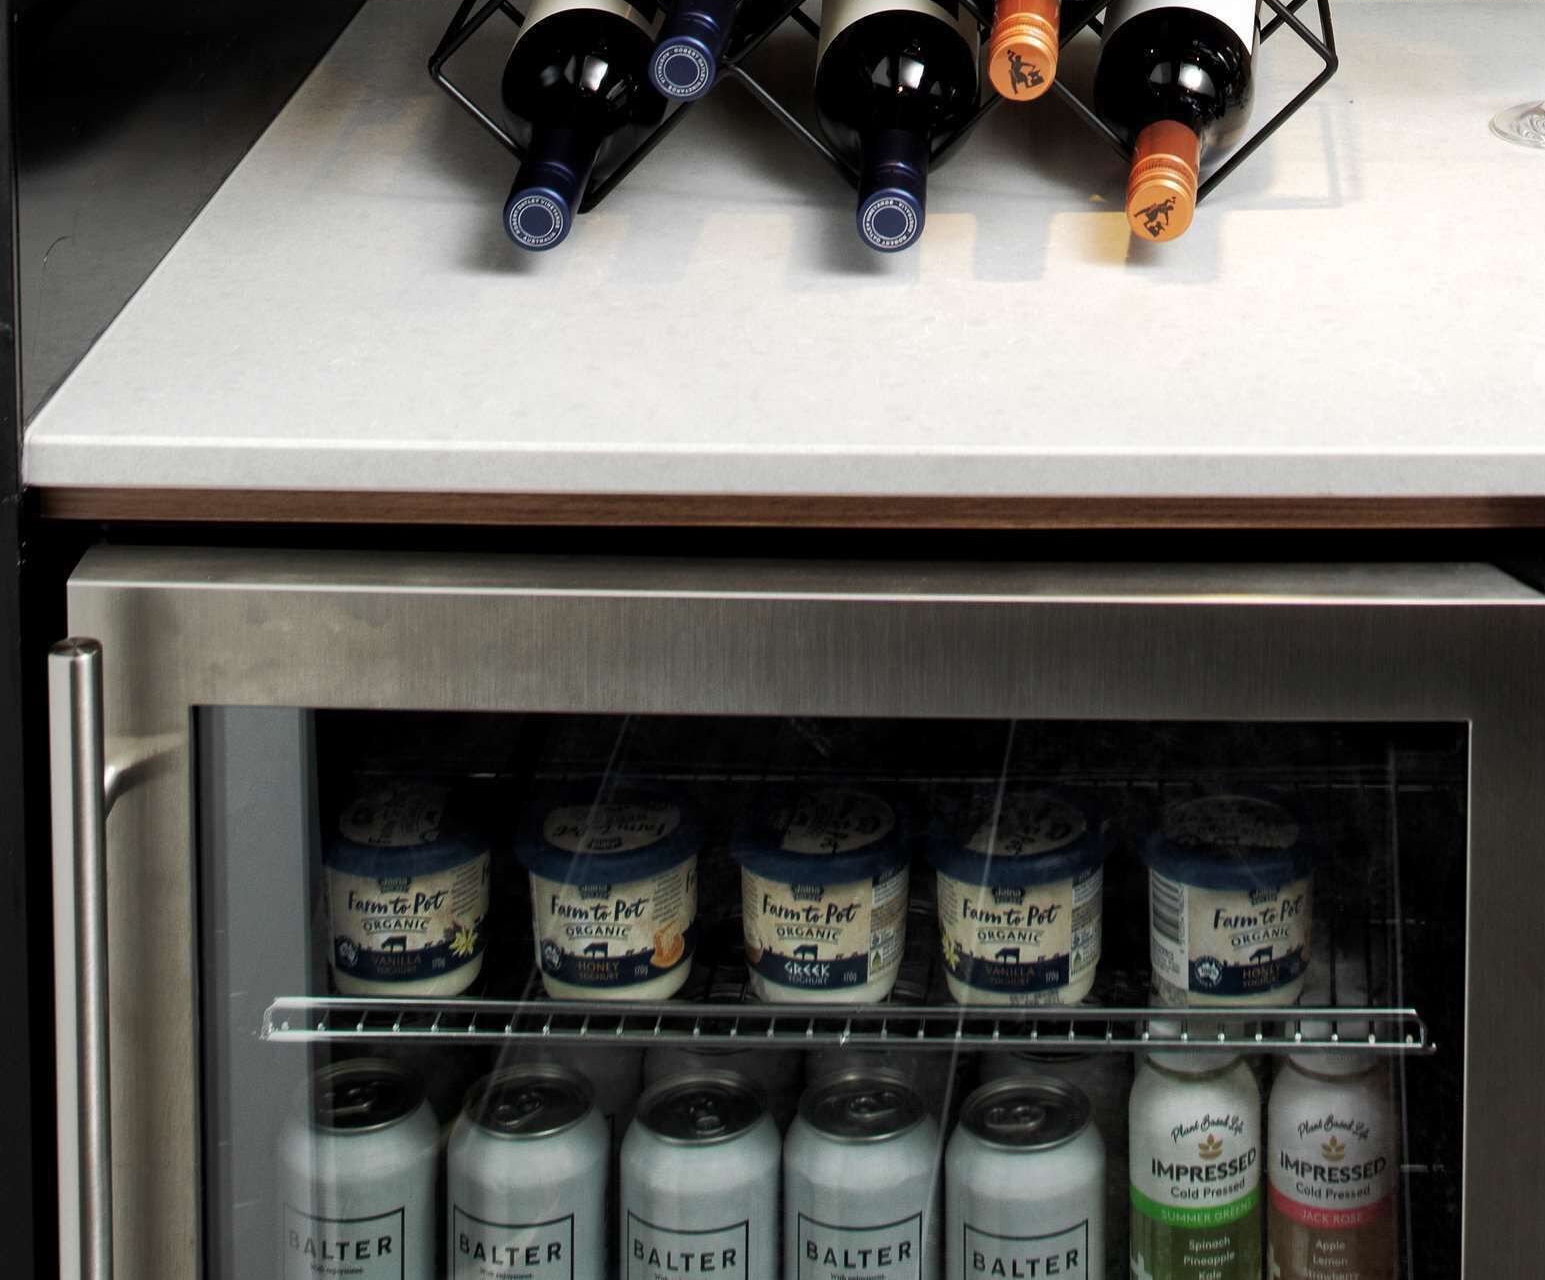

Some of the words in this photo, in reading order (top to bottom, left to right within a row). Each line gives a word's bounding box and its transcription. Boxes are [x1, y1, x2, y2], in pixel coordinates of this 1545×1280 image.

[348, 891, 386, 915] Farm
[390, 897, 408, 916] to
[413, 889, 450, 913] Pot
[551, 898, 589, 922] Farm
[592, 905, 610, 923] to
[615, 898, 650, 921] Pot
[762, 894, 801, 920] Farm
[804, 903, 822, 922] to
[825, 902, 860, 924] Pot
[963, 898, 1000, 923] Farm
[1004, 907, 1023, 925] to
[1027, 904, 1062, 927] Pot
[1214, 907, 1258, 930] Farm
[1260, 907, 1276, 925] to
[1280, 894, 1304, 921] Pot
[362, 919, 430, 931] ORGANIC
[565, 924, 630, 938] ORGANIC
[776, 926, 838, 940] ORGANIC
[978, 929, 1042, 943] ORGANIC
[1230, 927, 1289, 947] ORGANIC
[1152, 1146, 1257, 1183] IMPRESSED
[1280, 1151, 1387, 1184] IMPRESSED
[1171, 1186, 1199, 1200] Cold
[1203, 1179, 1245, 1198] Pressed
[1296, 1183, 1324, 1197] Cold
[1326, 1185, 1370, 1201] Pressed
[1162, 1206, 1210, 1224] SUMMER
[1302, 1210, 1329, 1224] JACK
[1333, 1213, 1362, 1224] ROSE
[288, 1231, 392, 1261] BALTER
[458, 1232, 562, 1267] BALTER
[1189, 1237, 1230, 1251] Spinach
[1316, 1239, 1345, 1251] Apple
[634, 1238, 737, 1272] BALTER
[806, 1241, 911, 1269] BALTER
[973, 1249, 1079, 1280] BALTER
[1184, 1252, 1235, 1267] Pineapple
[1313, 1254, 1348, 1266] Lemon
